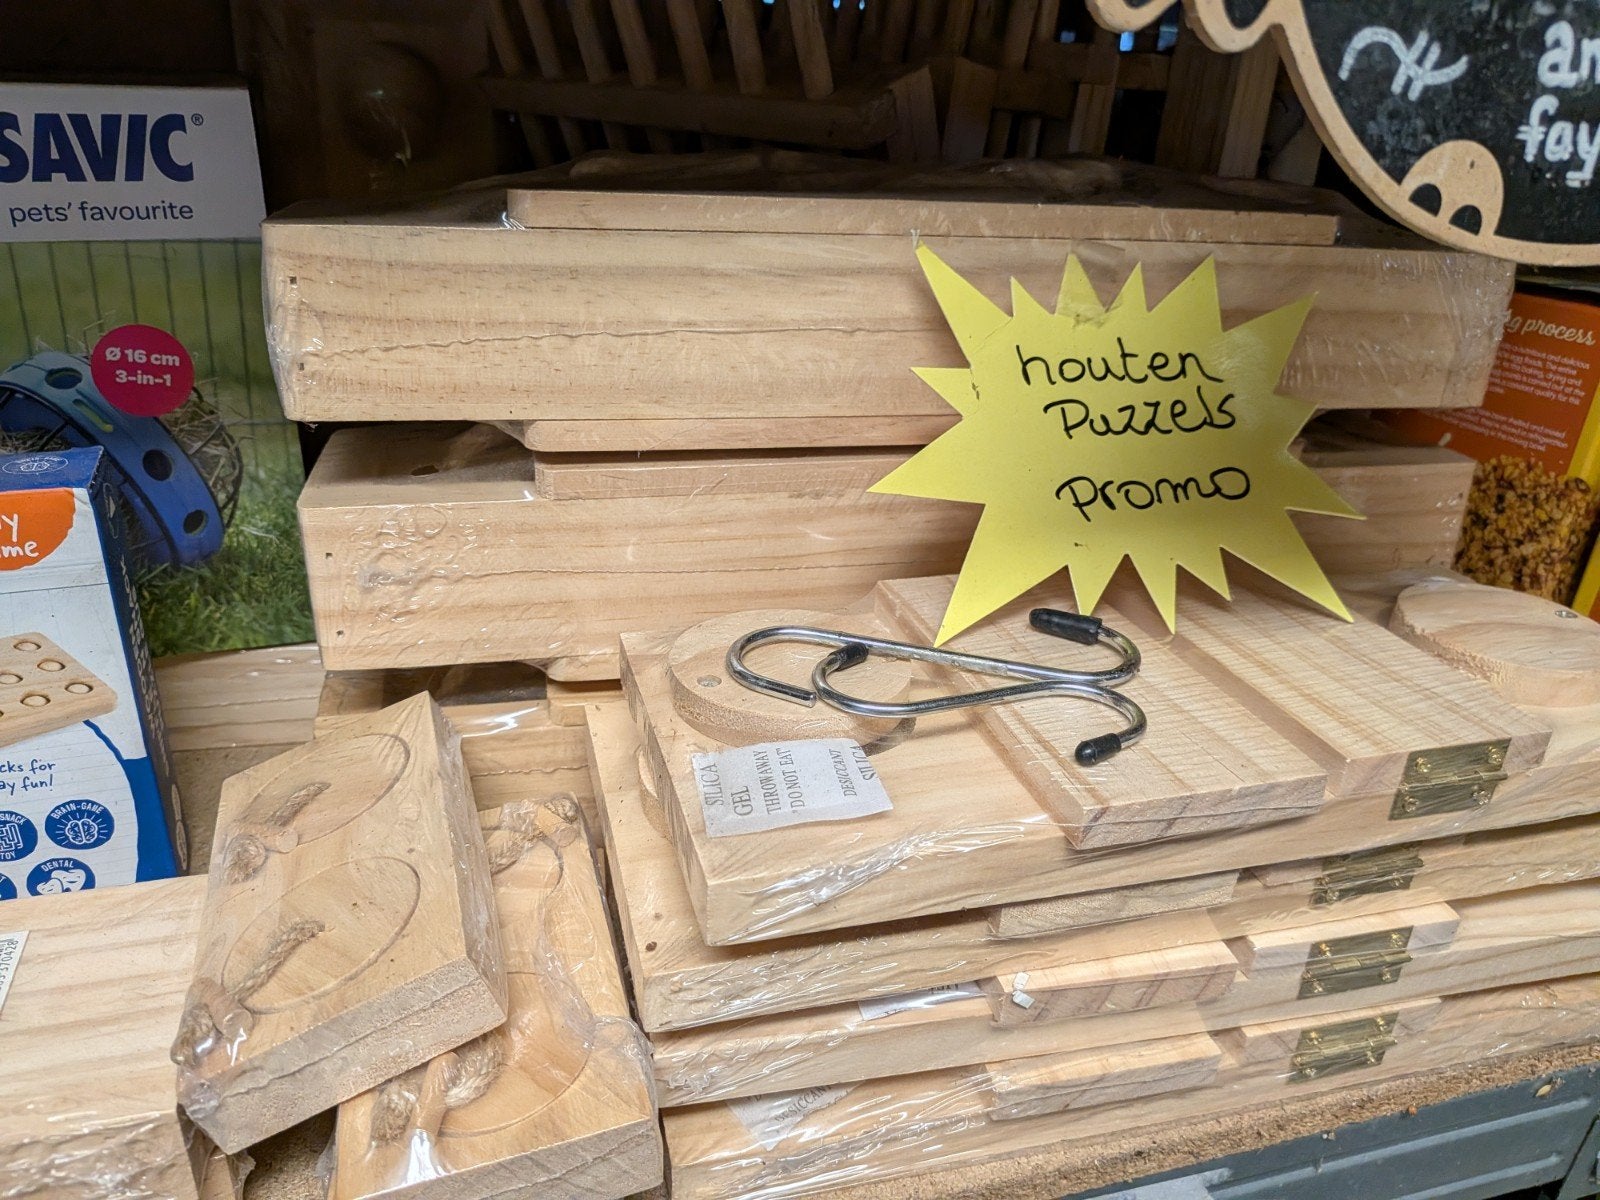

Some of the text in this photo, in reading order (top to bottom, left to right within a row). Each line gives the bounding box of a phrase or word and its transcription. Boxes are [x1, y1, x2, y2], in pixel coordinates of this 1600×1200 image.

[78, 200, 194, 223] favourite
[1521, 318, 1596, 346] process
[124, 348, 147, 363] 16
[150, 353, 180, 367] cm
[1015, 336, 1225, 386] houten
[115, 369, 172, 387] 3-in-1
[29, 758, 56, 775] for
[828, 748, 858, 797] DESICCANT
[20, 773, 54, 792] fun!
[700, 762, 725, 807] SILICA
[50, 802, 105, 820] BRAIN-GAME
[731, 785, 754, 817] GEL
[41, 859, 75, 873] DENTAL
